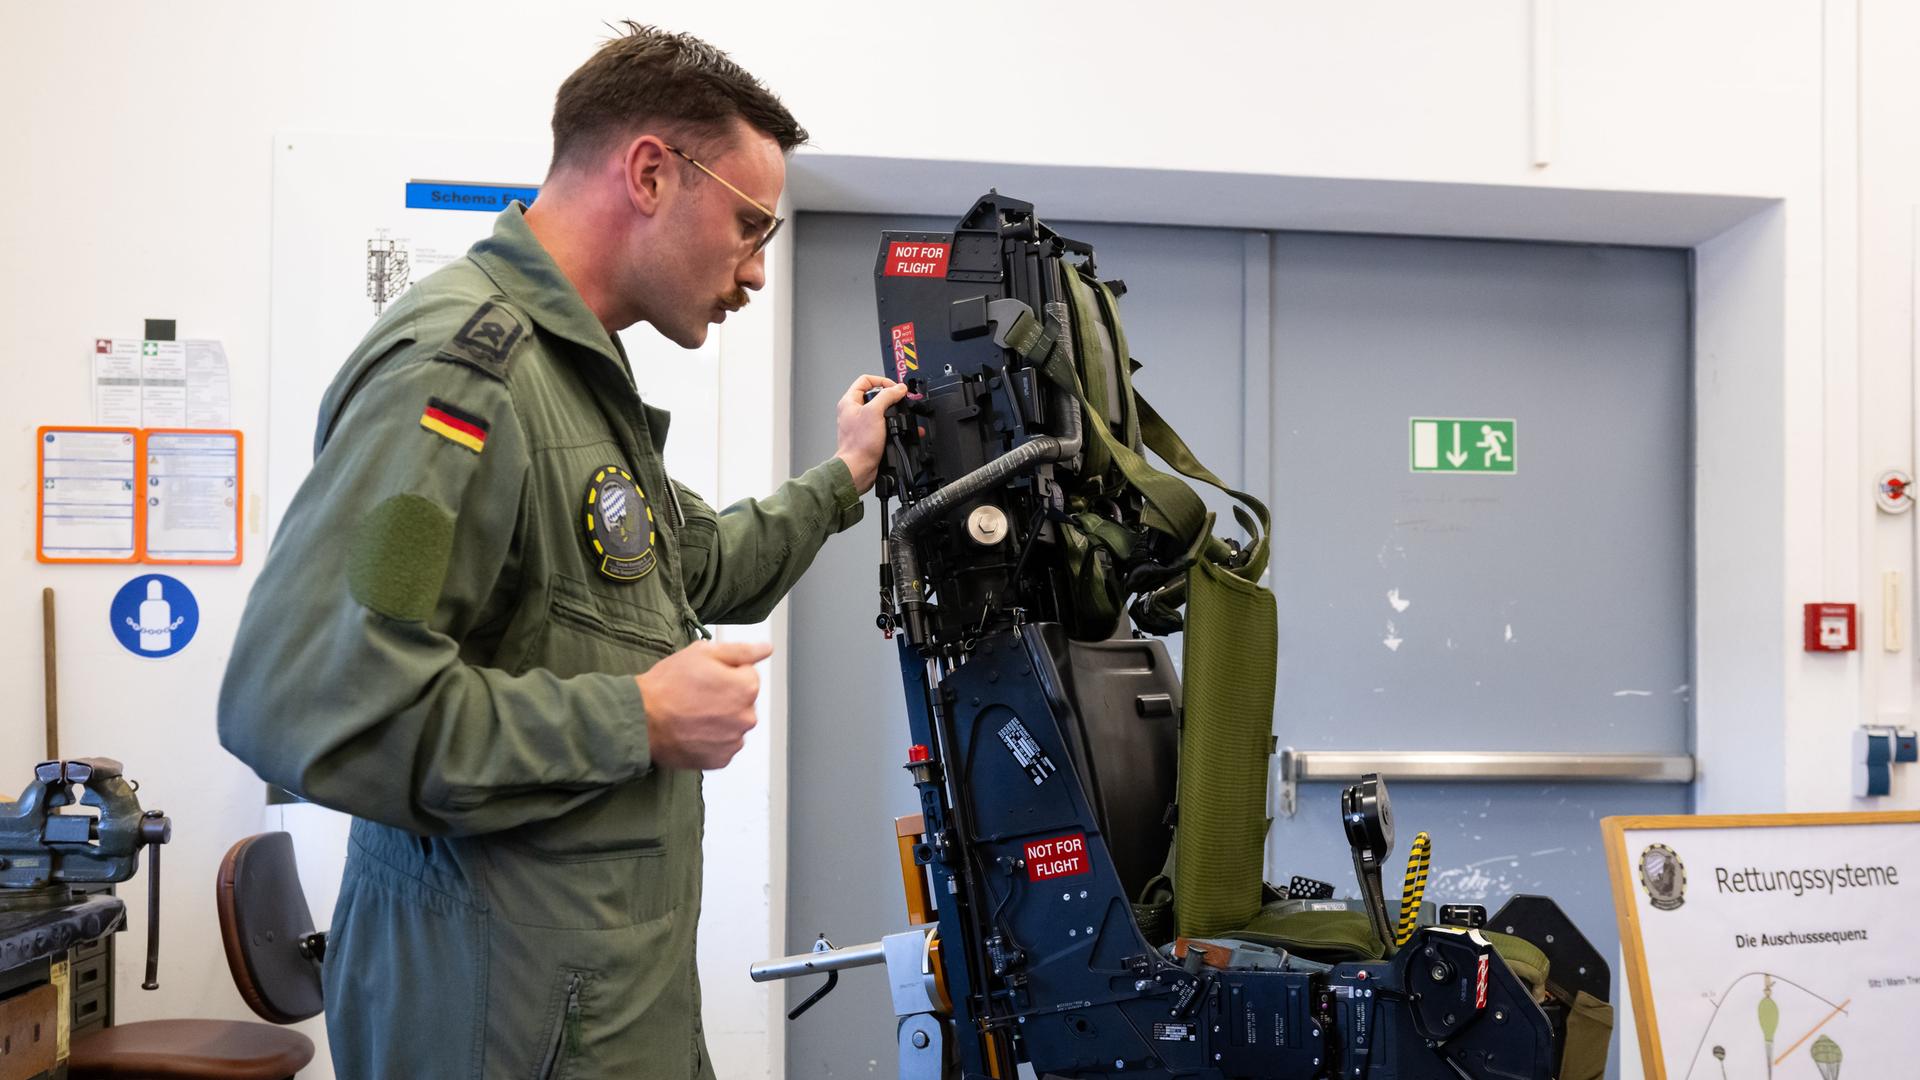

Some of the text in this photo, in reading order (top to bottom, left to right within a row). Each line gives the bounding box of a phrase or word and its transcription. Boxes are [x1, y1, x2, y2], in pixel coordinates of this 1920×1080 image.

[431, 190, 497, 205] Schema
[896, 246, 944, 258] NOT FOR
[897, 262, 936, 273] FLIGHT
[892, 329, 907, 382] DANGE
[1027, 838, 1082, 859] NOT FOR
[1036, 857, 1079, 877] FLIGHT
[1715, 864, 1900, 896] Rettungssysteme
[1735, 929, 1868, 949] Die Auschusssequenz
